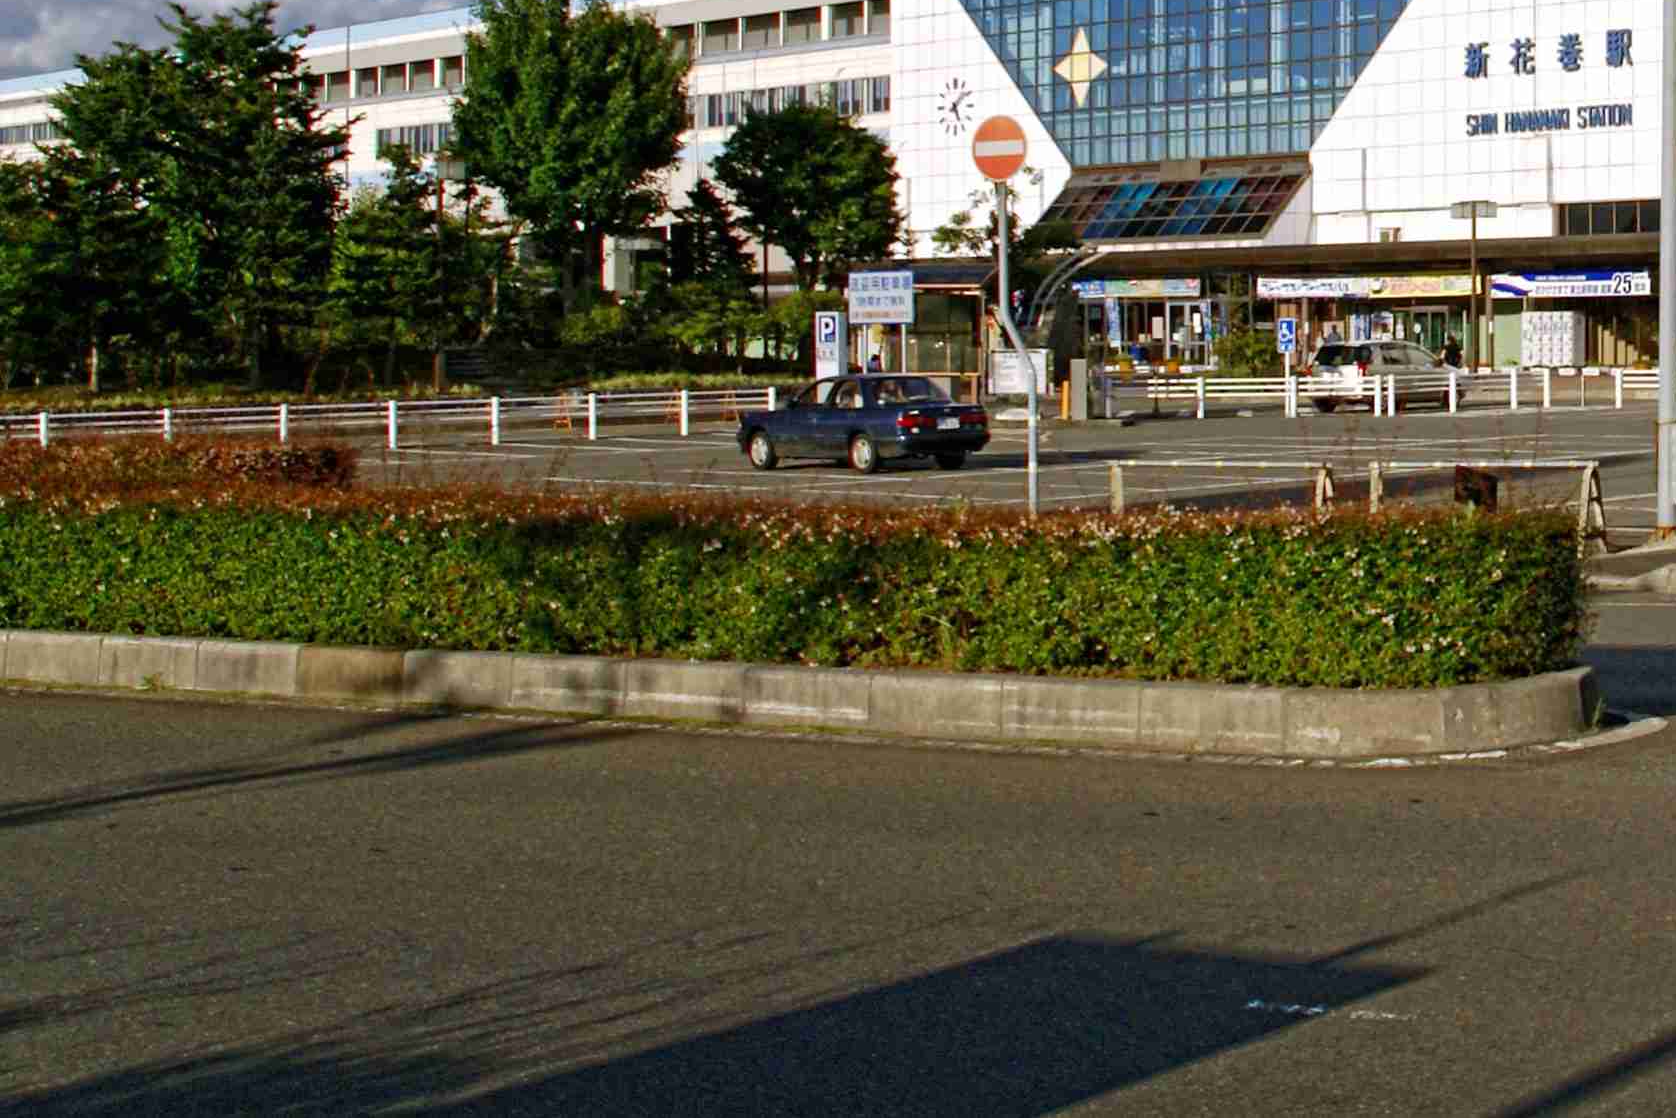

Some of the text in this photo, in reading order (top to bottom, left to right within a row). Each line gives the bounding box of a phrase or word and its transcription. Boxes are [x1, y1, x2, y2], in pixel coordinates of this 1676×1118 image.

[1464, 29, 1633, 79] 新花巻駅
[1466, 103, 1633, 136] SHIN HANAMAKI STATION
[1613, 274, 1632, 294] 25
[820, 317, 834, 342] P
